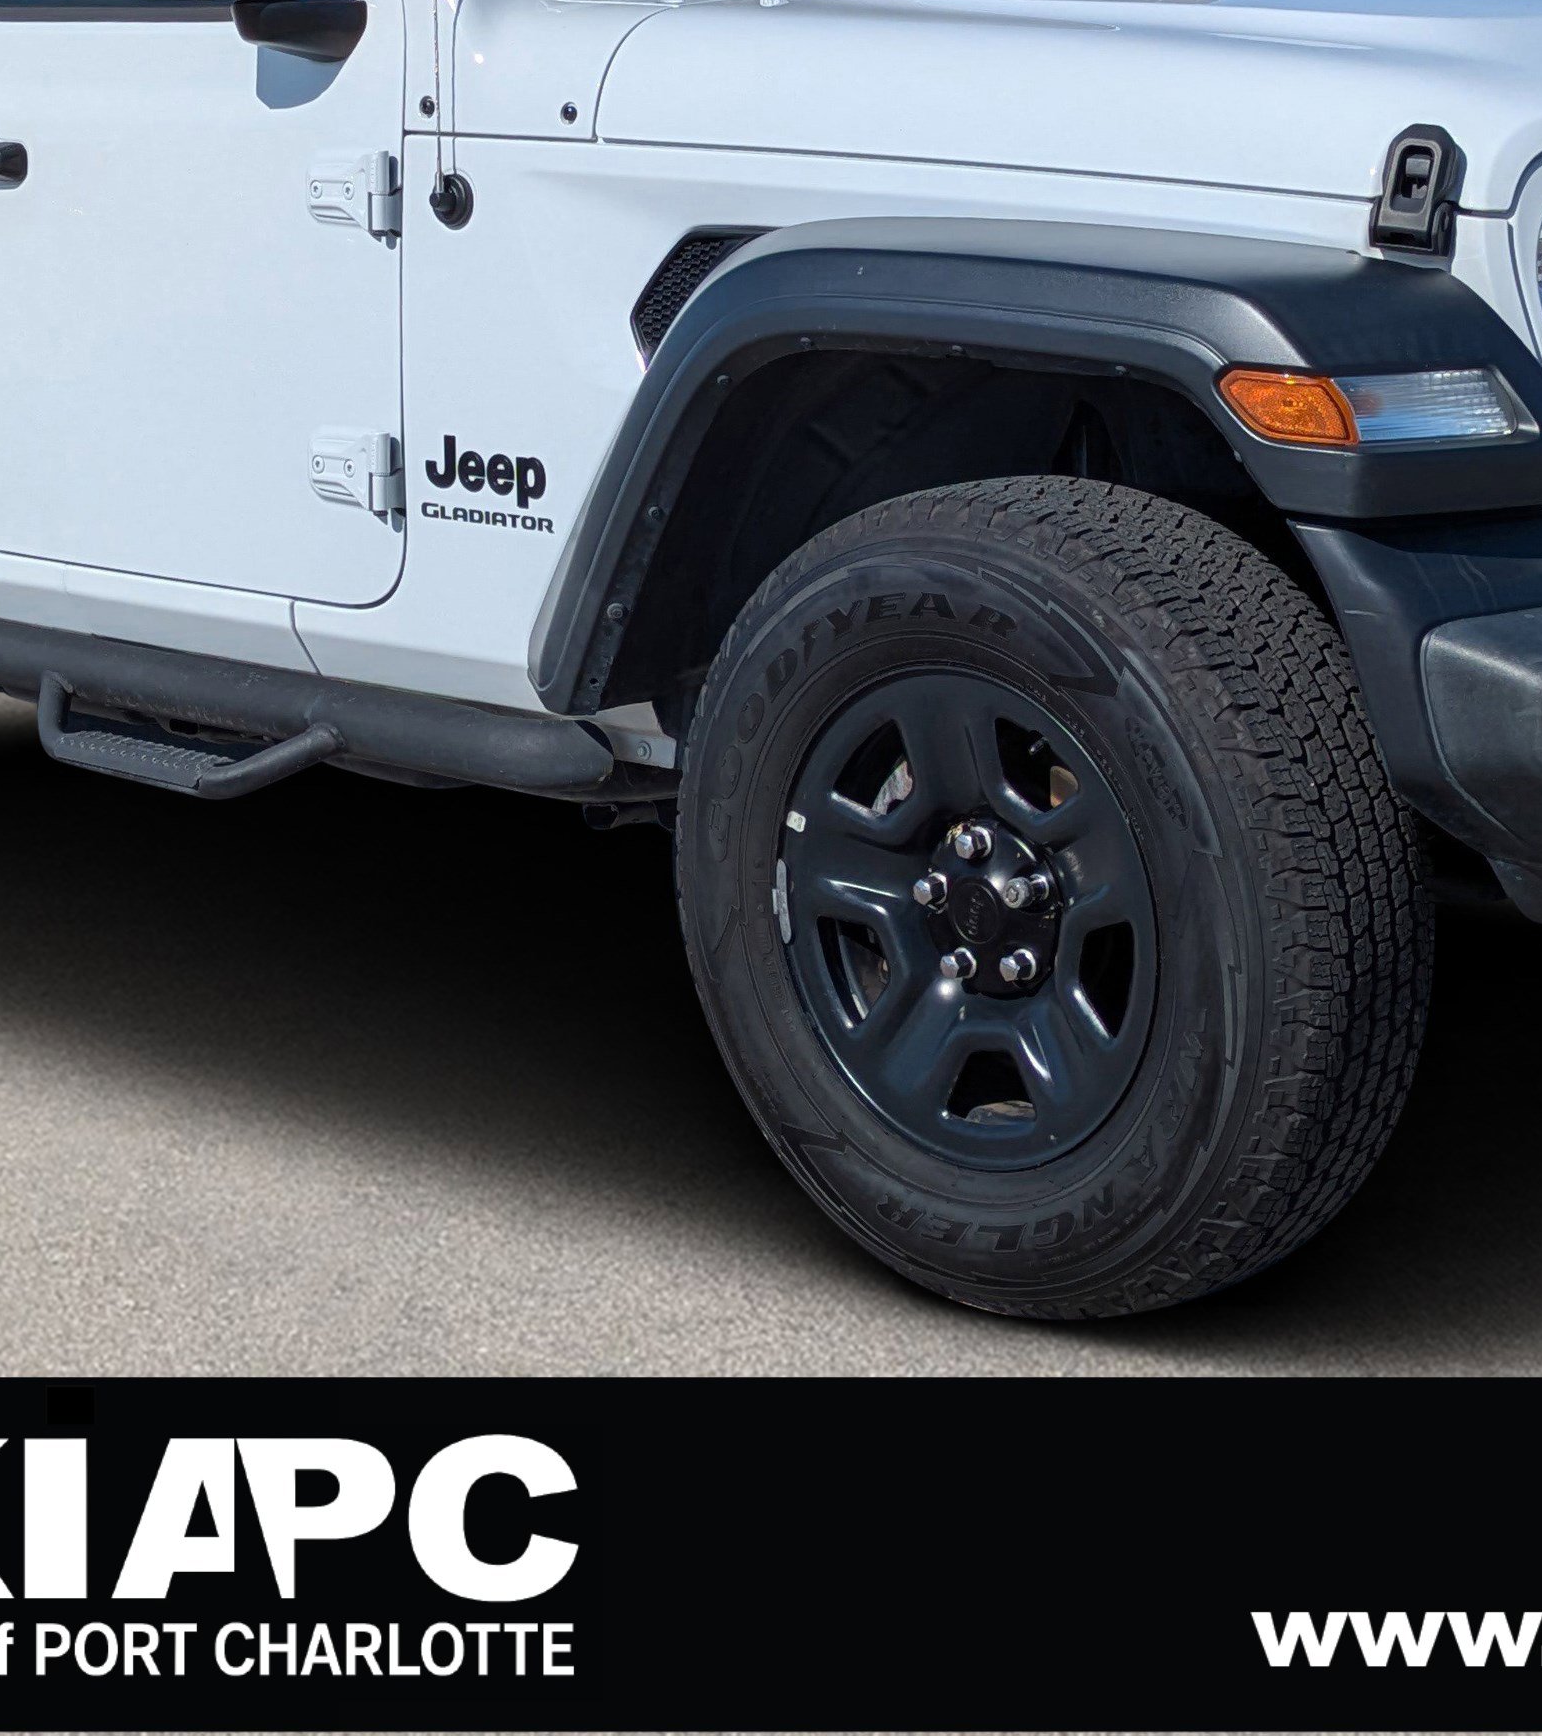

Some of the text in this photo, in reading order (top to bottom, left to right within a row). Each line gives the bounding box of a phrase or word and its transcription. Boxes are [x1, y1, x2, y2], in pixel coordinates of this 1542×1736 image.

[424, 434, 547, 509] Jeep
[420, 501, 556, 535] GLADIATOR
[874, 1006, 1209, 1254] WRANGLER
